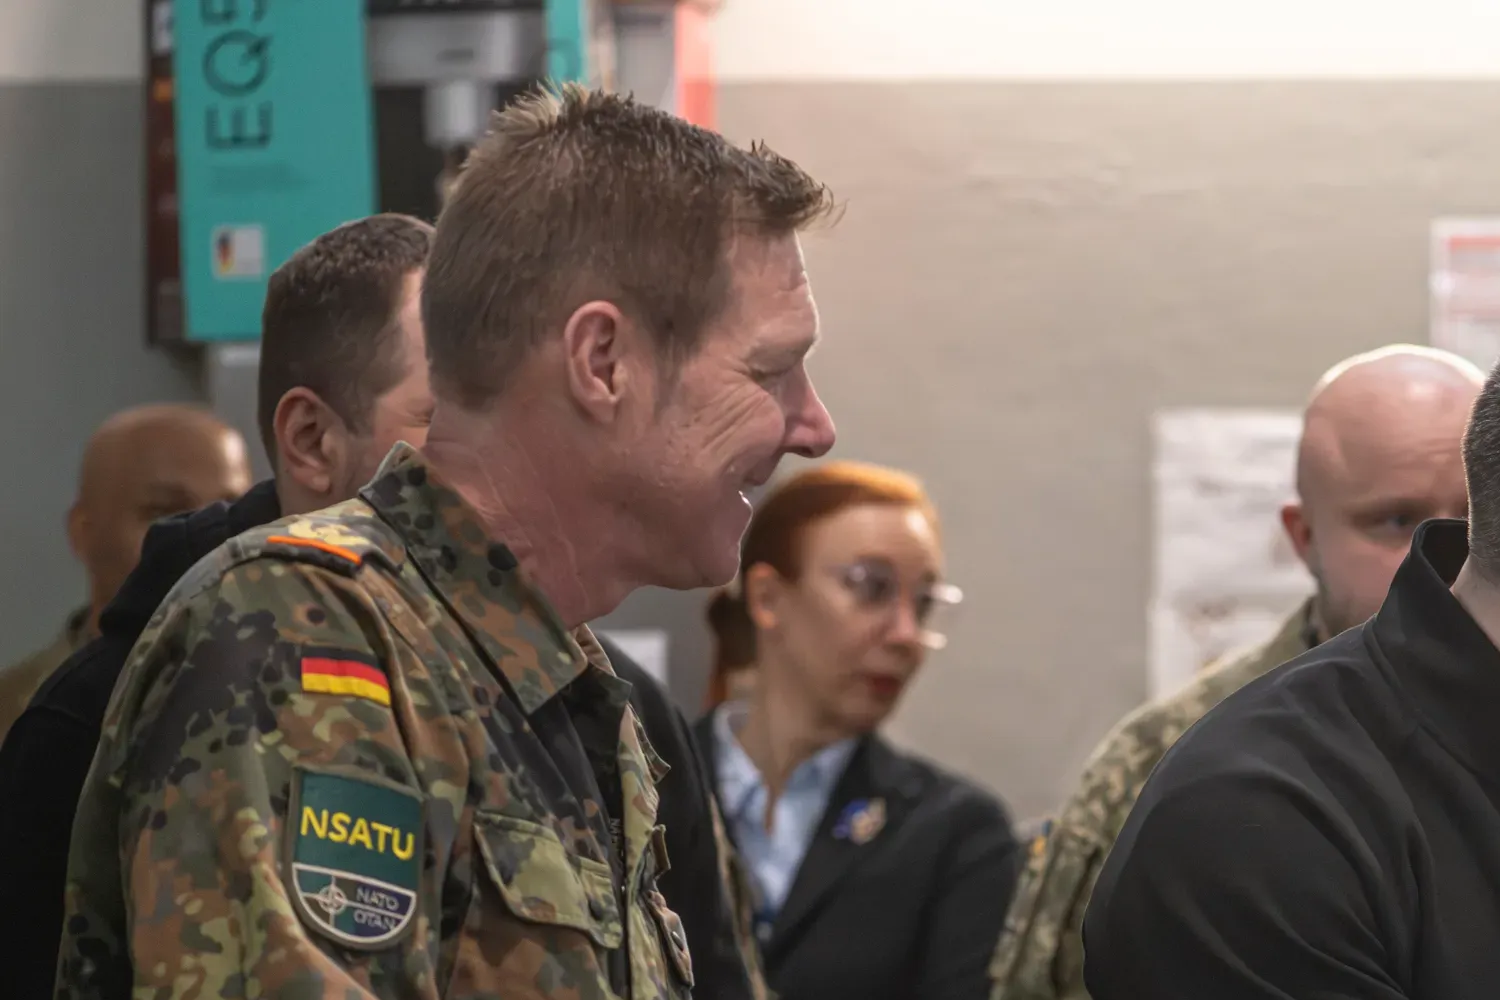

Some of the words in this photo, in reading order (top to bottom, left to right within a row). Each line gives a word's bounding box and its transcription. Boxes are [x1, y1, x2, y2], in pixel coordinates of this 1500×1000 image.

[301, 806, 416, 861] NSATU
[357, 887, 400, 911] NATO
[353, 909, 397, 932] OTAN
